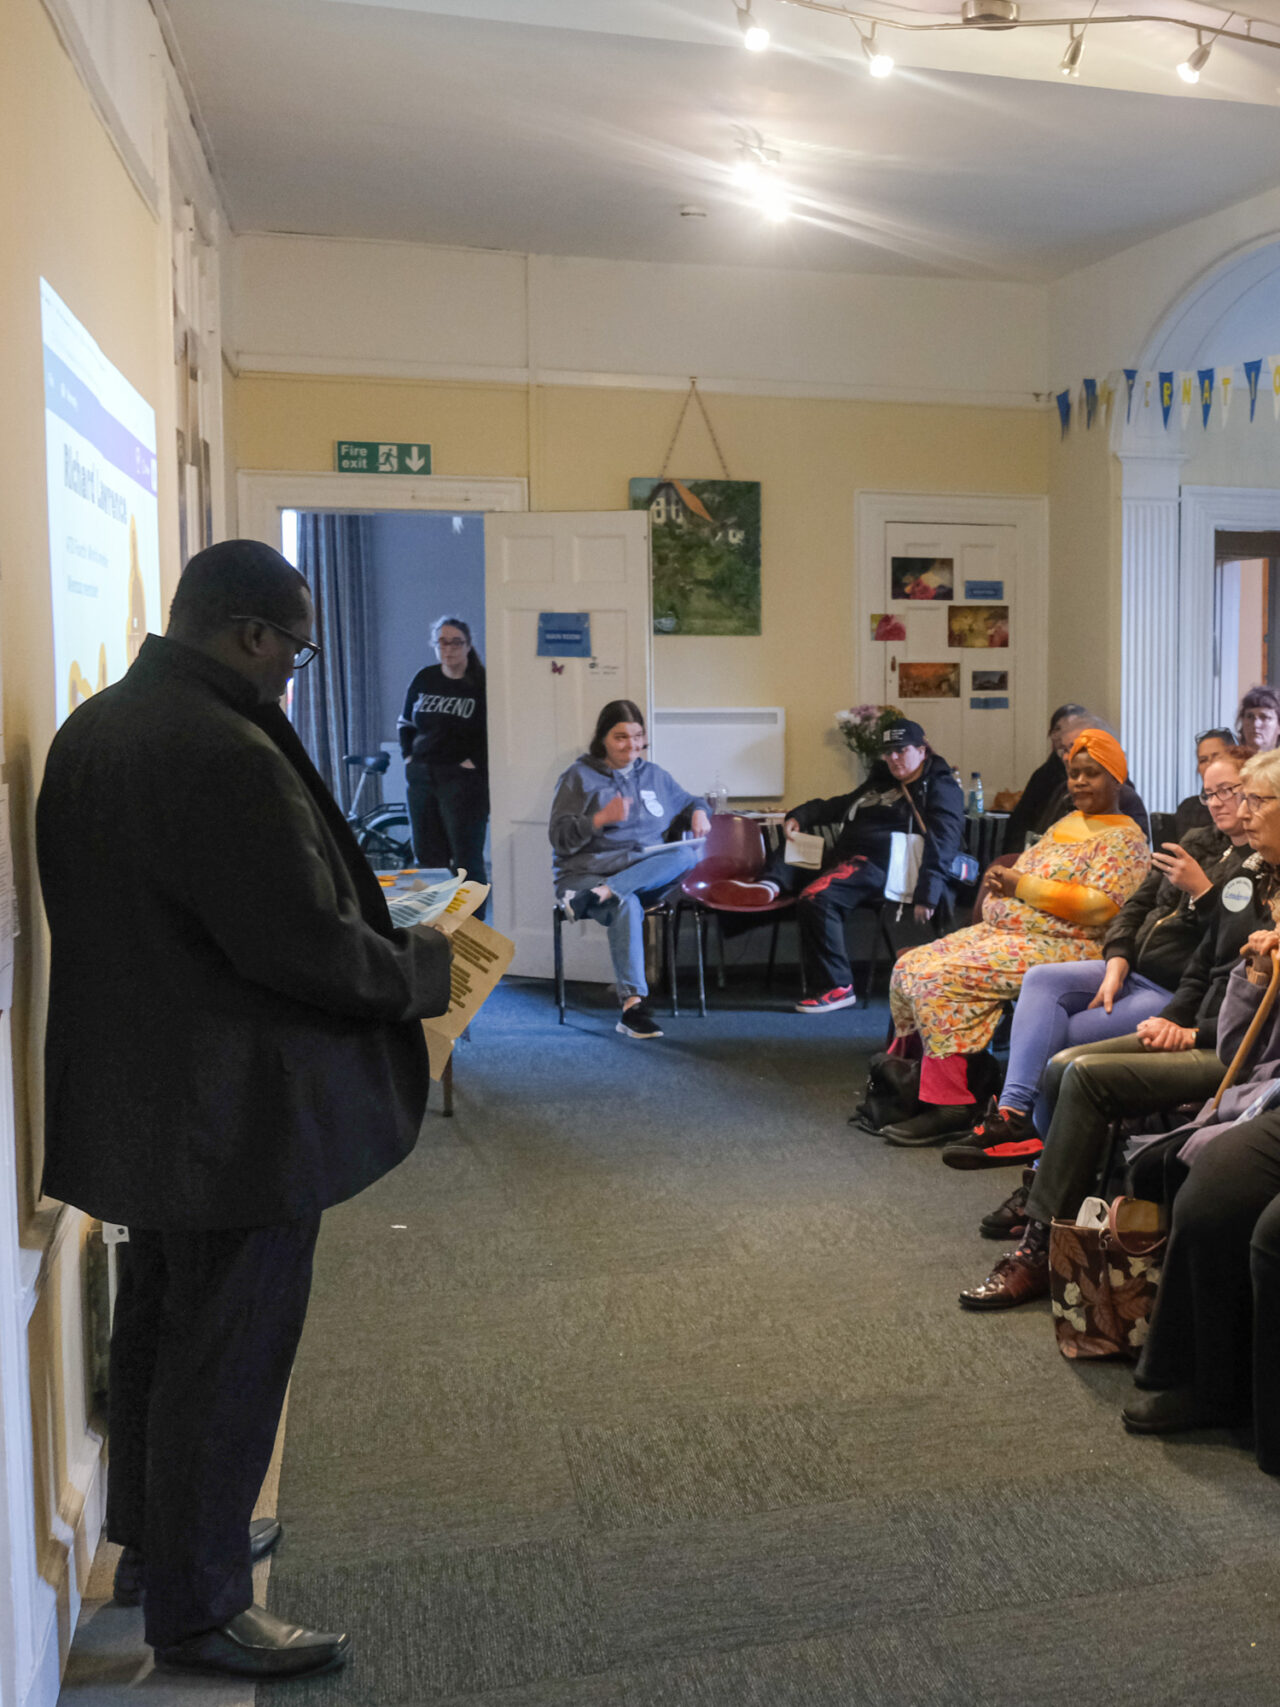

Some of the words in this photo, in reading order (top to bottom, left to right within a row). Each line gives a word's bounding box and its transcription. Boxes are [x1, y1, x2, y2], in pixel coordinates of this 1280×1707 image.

[340, 444, 368, 457] Fire
[341, 457, 368, 469] exit
[413, 692, 476, 719] WEEKEND
